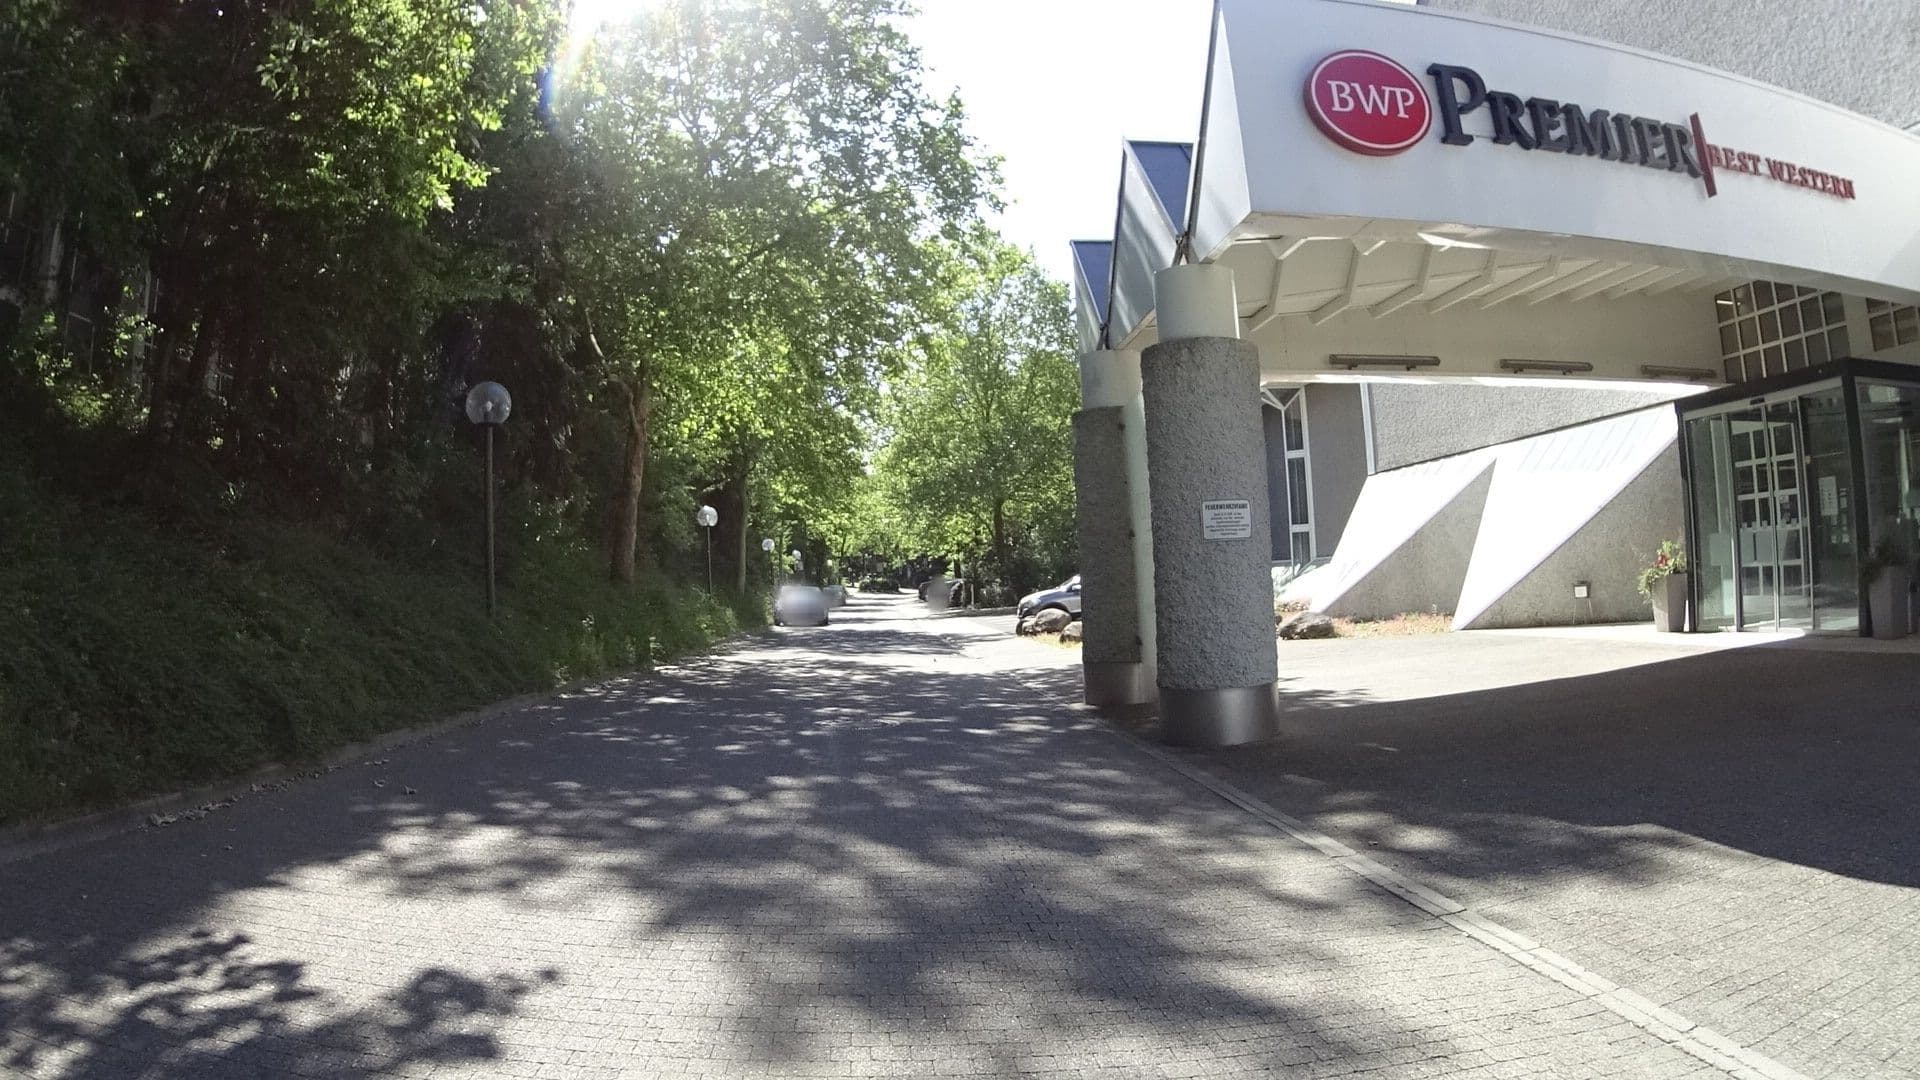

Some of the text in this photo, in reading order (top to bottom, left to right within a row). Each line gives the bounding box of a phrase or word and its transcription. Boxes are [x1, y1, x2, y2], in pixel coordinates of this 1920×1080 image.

[1328, 80, 1415, 119] BWP
[1427, 63, 1856, 199] PREMIER BEST WESTERN
